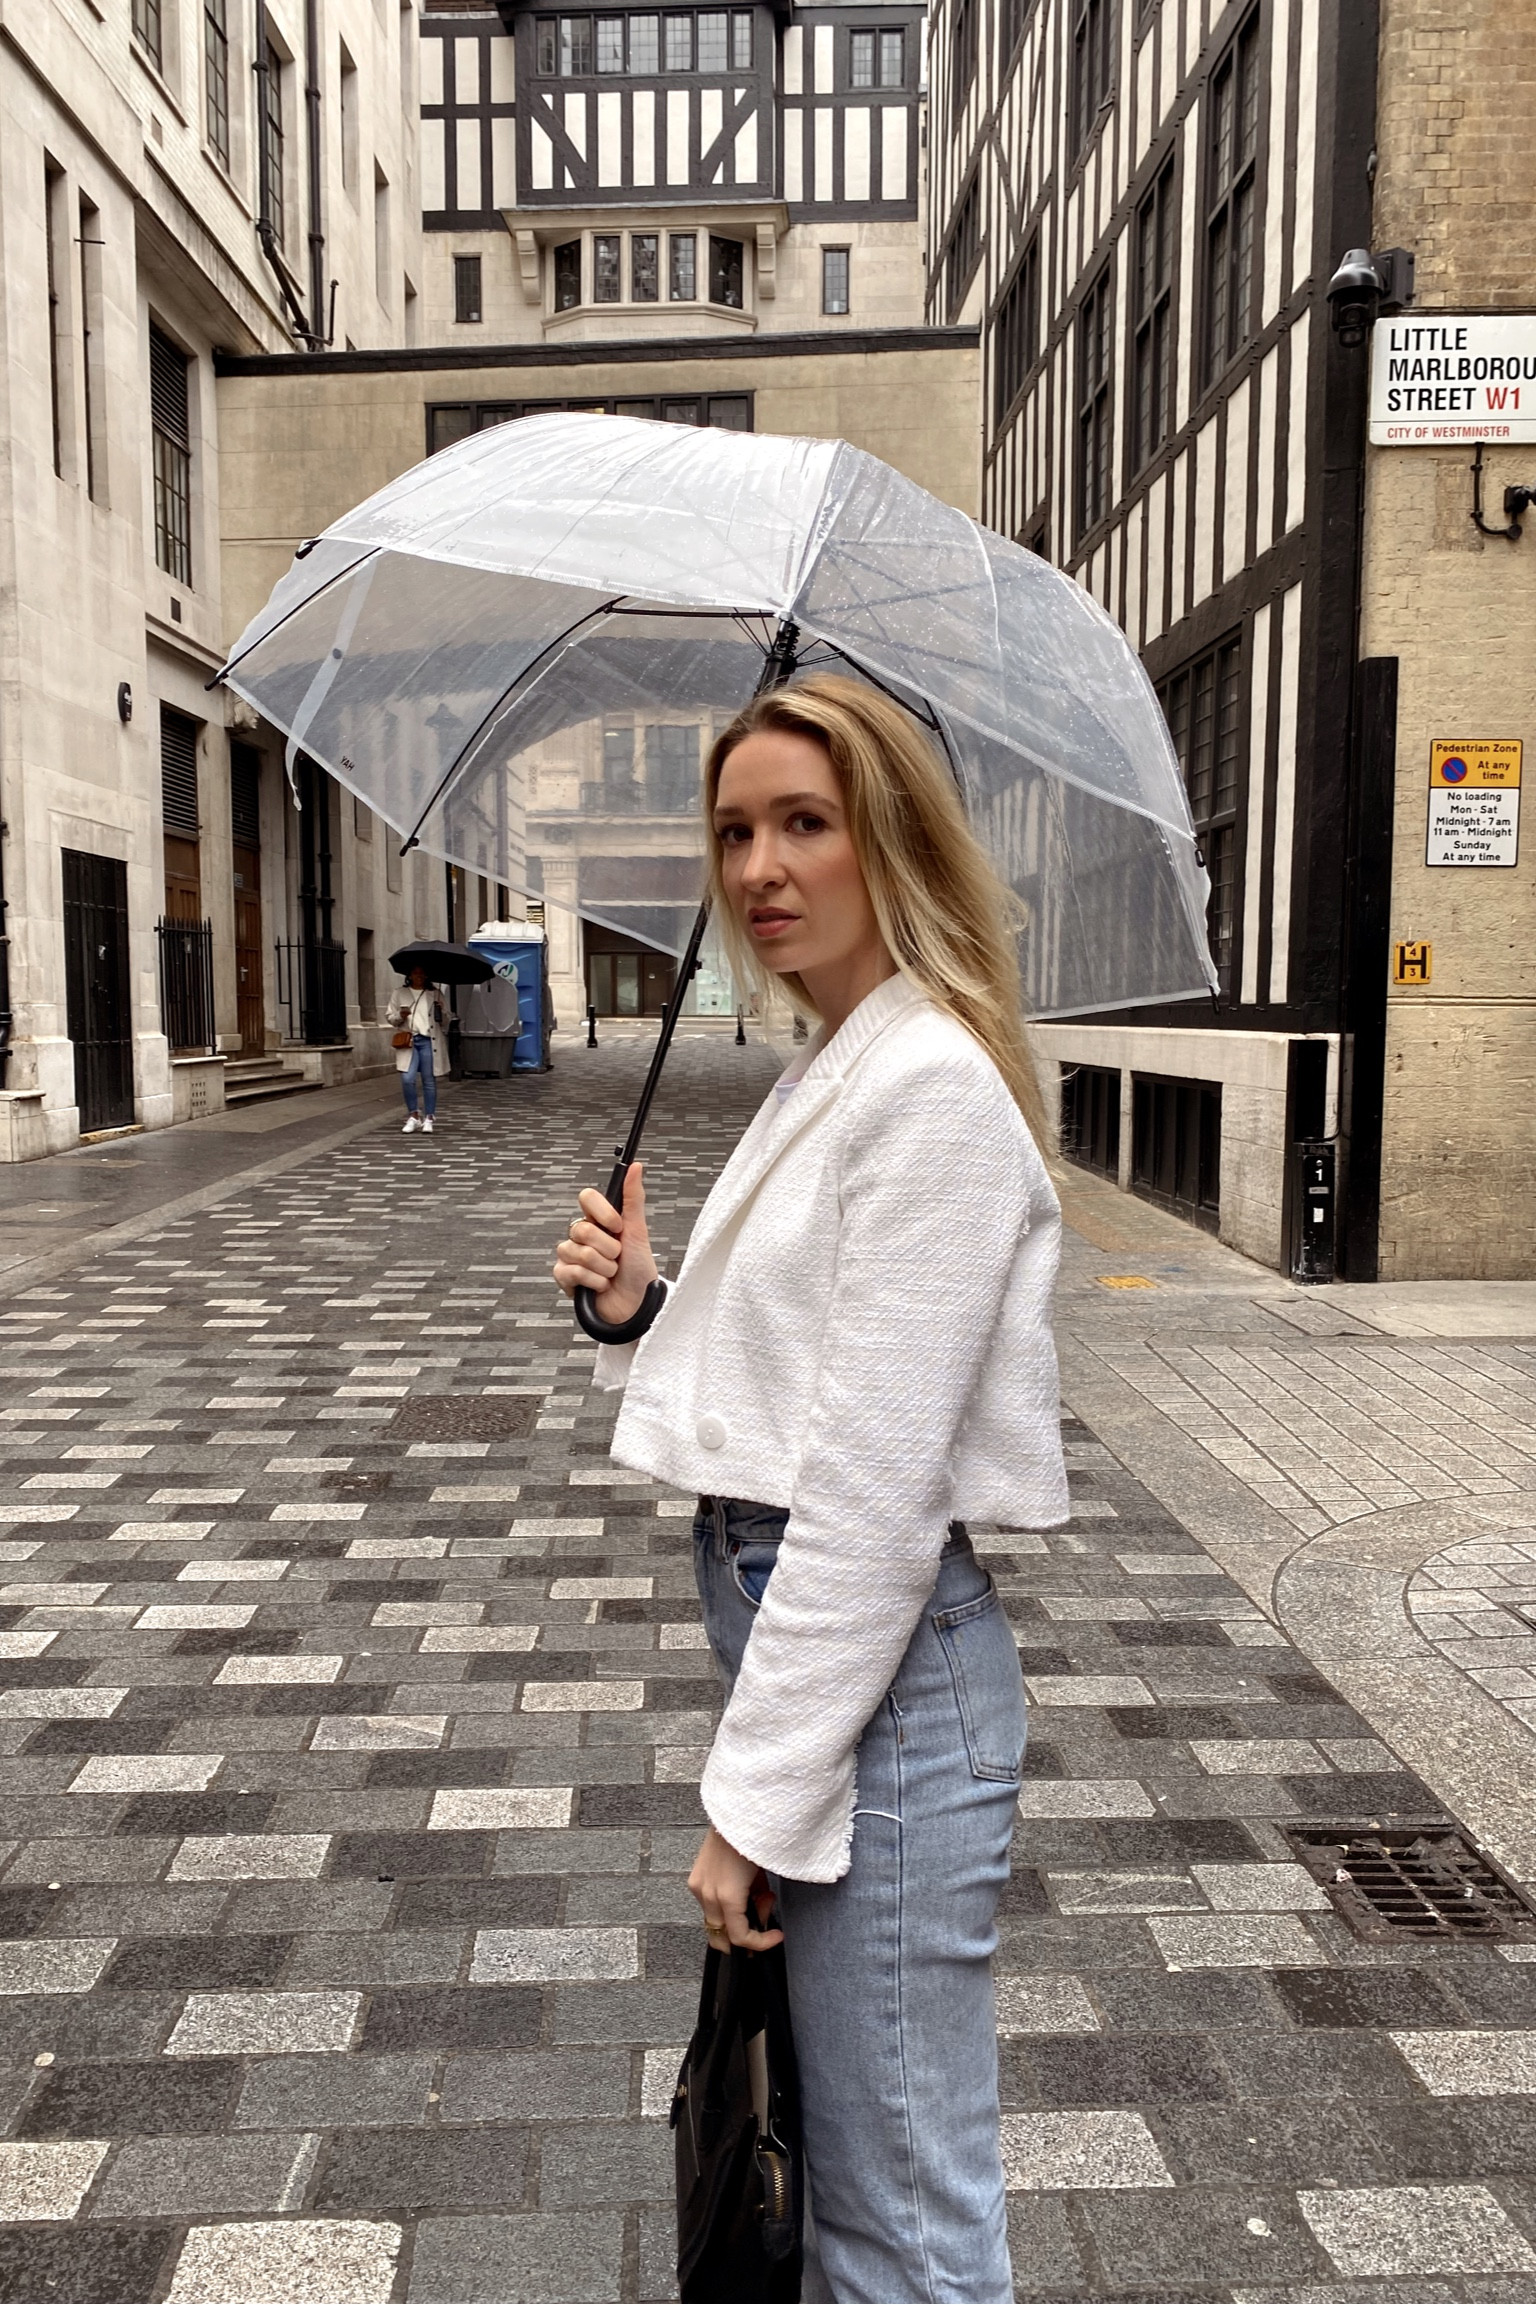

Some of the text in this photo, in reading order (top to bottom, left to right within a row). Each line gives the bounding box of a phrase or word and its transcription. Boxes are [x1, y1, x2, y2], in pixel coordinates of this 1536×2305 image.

[1390, 328, 1467, 351] LITTLE
[1389, 357, 1536, 381] MARLBOROU
[1387, 387, 1520, 411] STREET W1
[1387, 426, 1510, 438] CITY OF WESTMINSTER
[1436, 744, 1518, 753] Pedestrian Zone
[1477, 761, 1511, 771] At any
[1483, 772, 1505, 780] time
[1447, 792, 1502, 803] No loading
[1450, 805, 1472, 814] Mon
[1480, 805, 1498, 814] Sat
[1436, 817, 1481, 827] Midnight
[1467, 827, 1512, 838] Midnight
[1453, 840, 1491, 851] Sunday
[1442, 852, 1501, 863] At any time
[1409, 947, 1417, 957] 4
[1399, 945, 1427, 979] H
[1409, 967, 1416, 977] 3
[1315, 1168, 1323, 1181] 1
